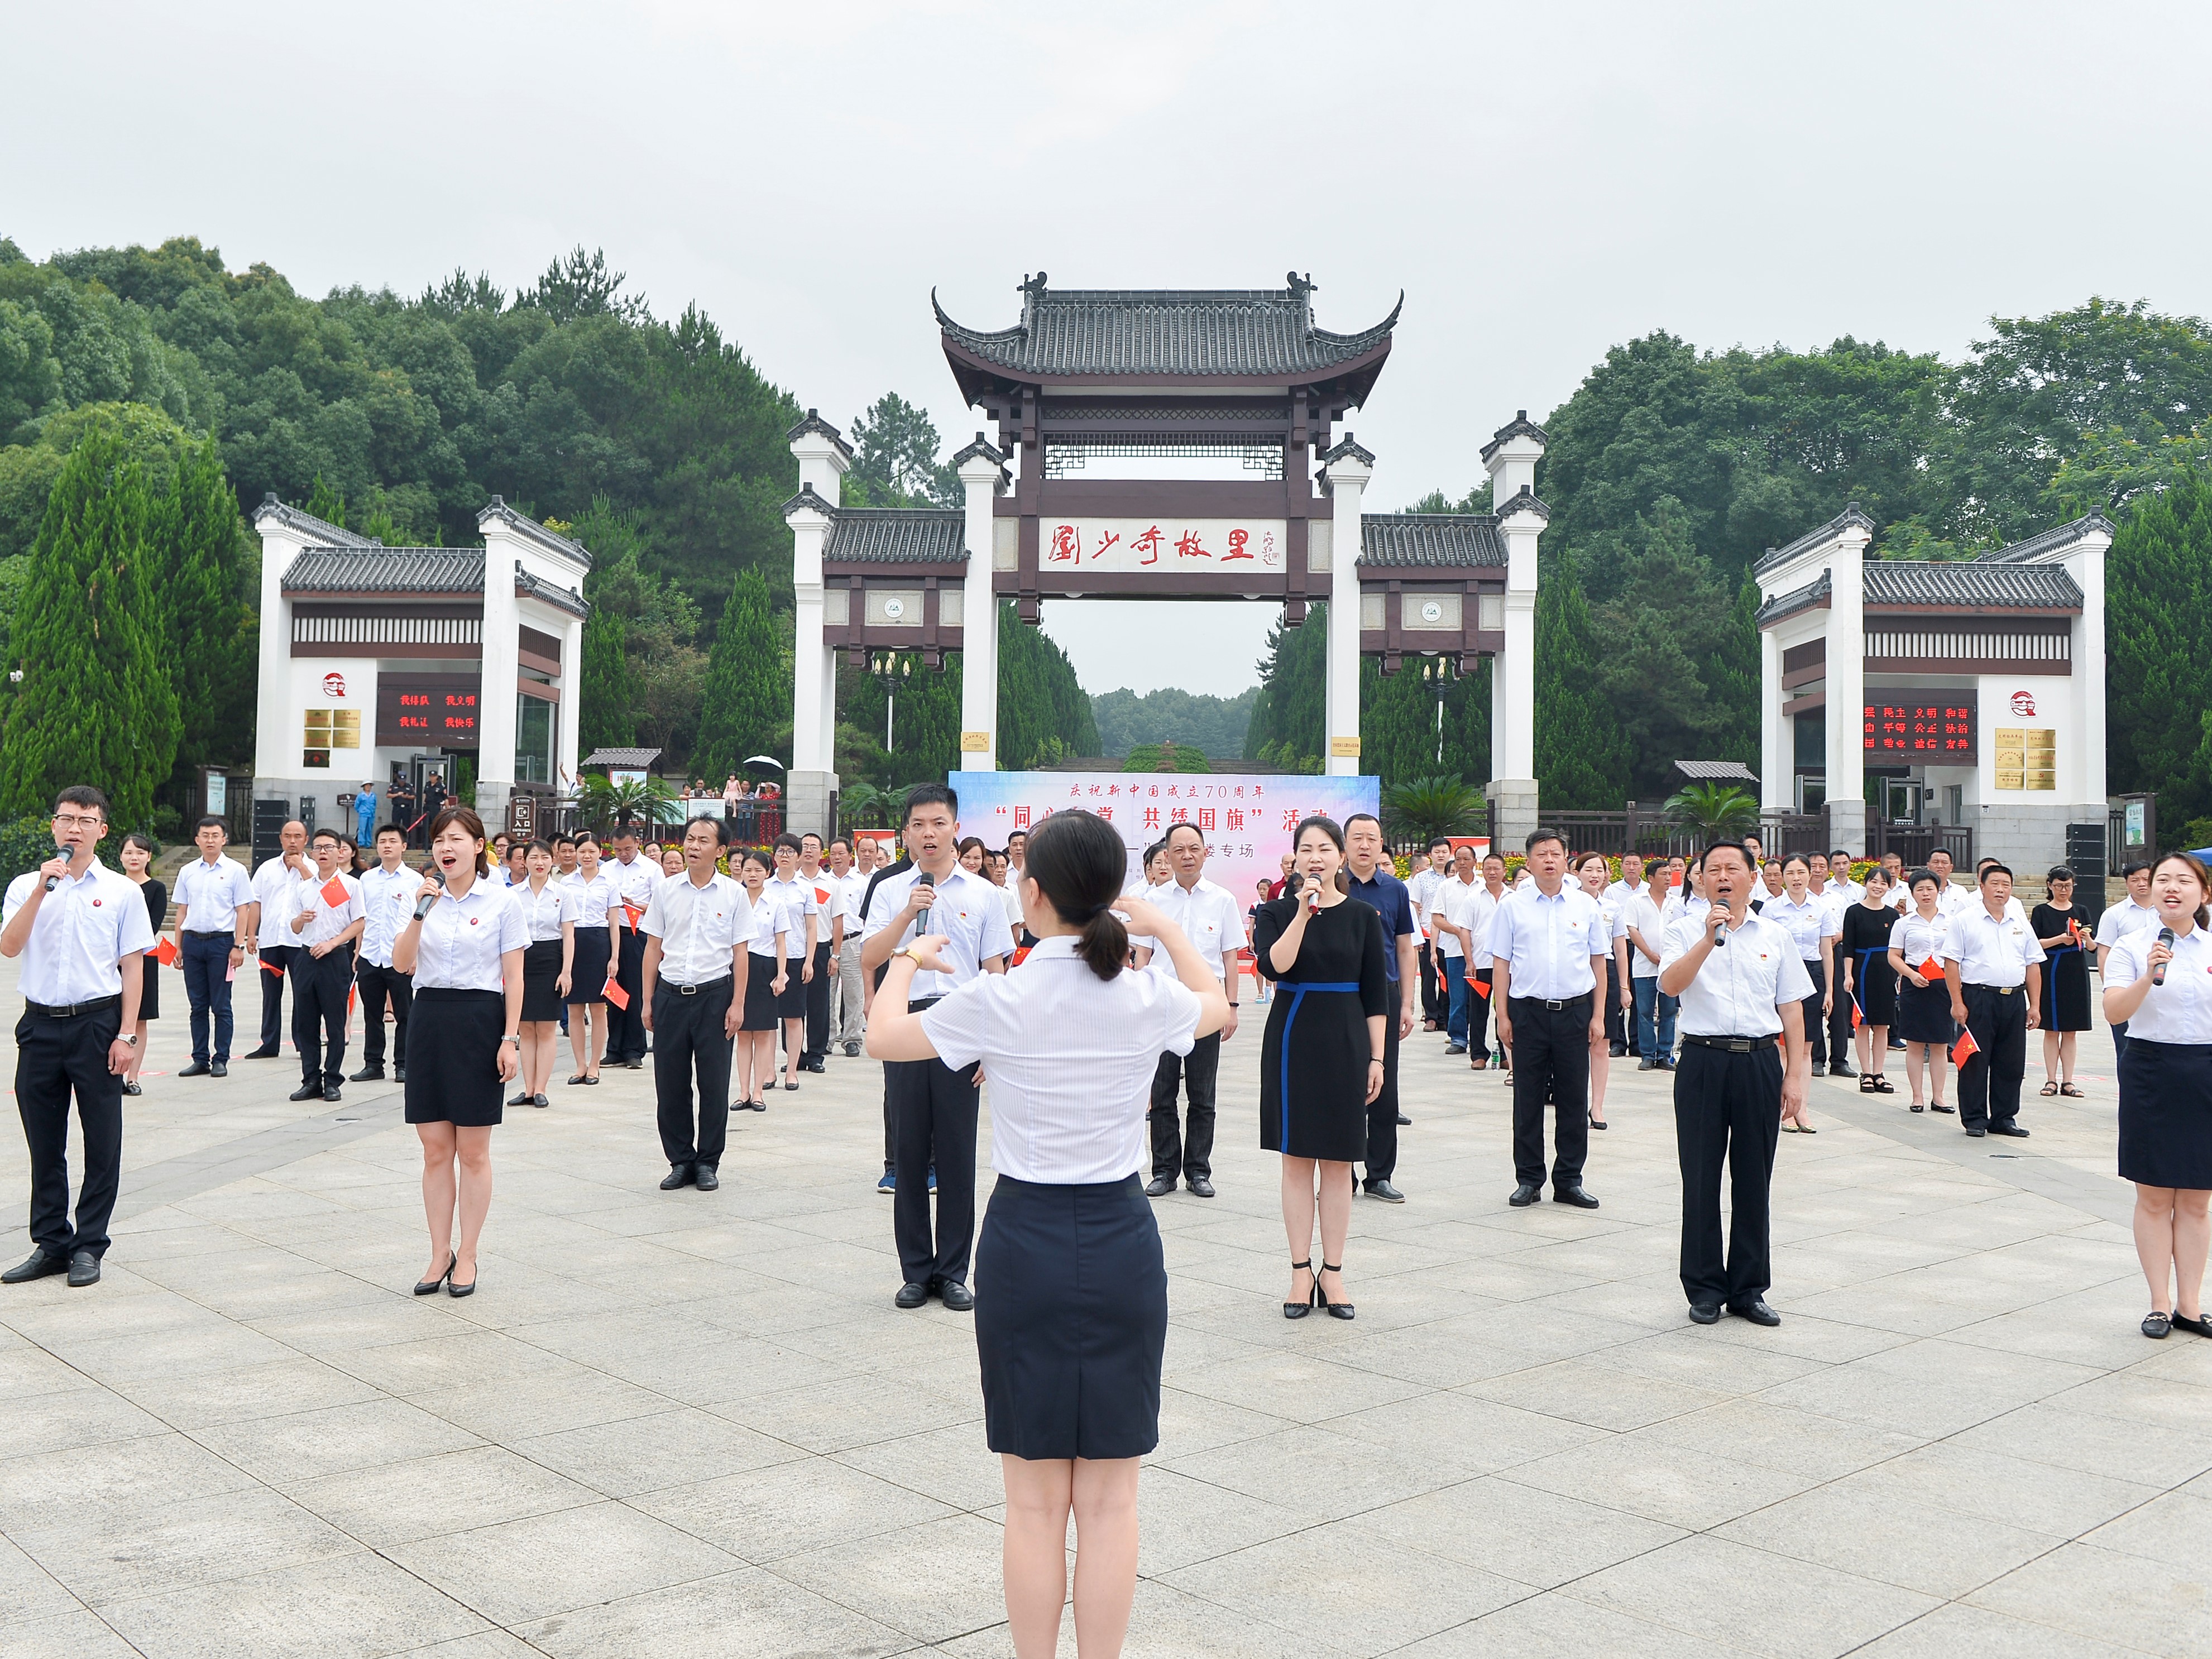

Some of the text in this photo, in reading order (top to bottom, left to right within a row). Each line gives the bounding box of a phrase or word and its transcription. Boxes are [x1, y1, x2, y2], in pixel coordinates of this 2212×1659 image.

[1914, 708, 1937, 718] 文明
[1070, 783, 1265, 800] 庆祝新中国成立70周年
